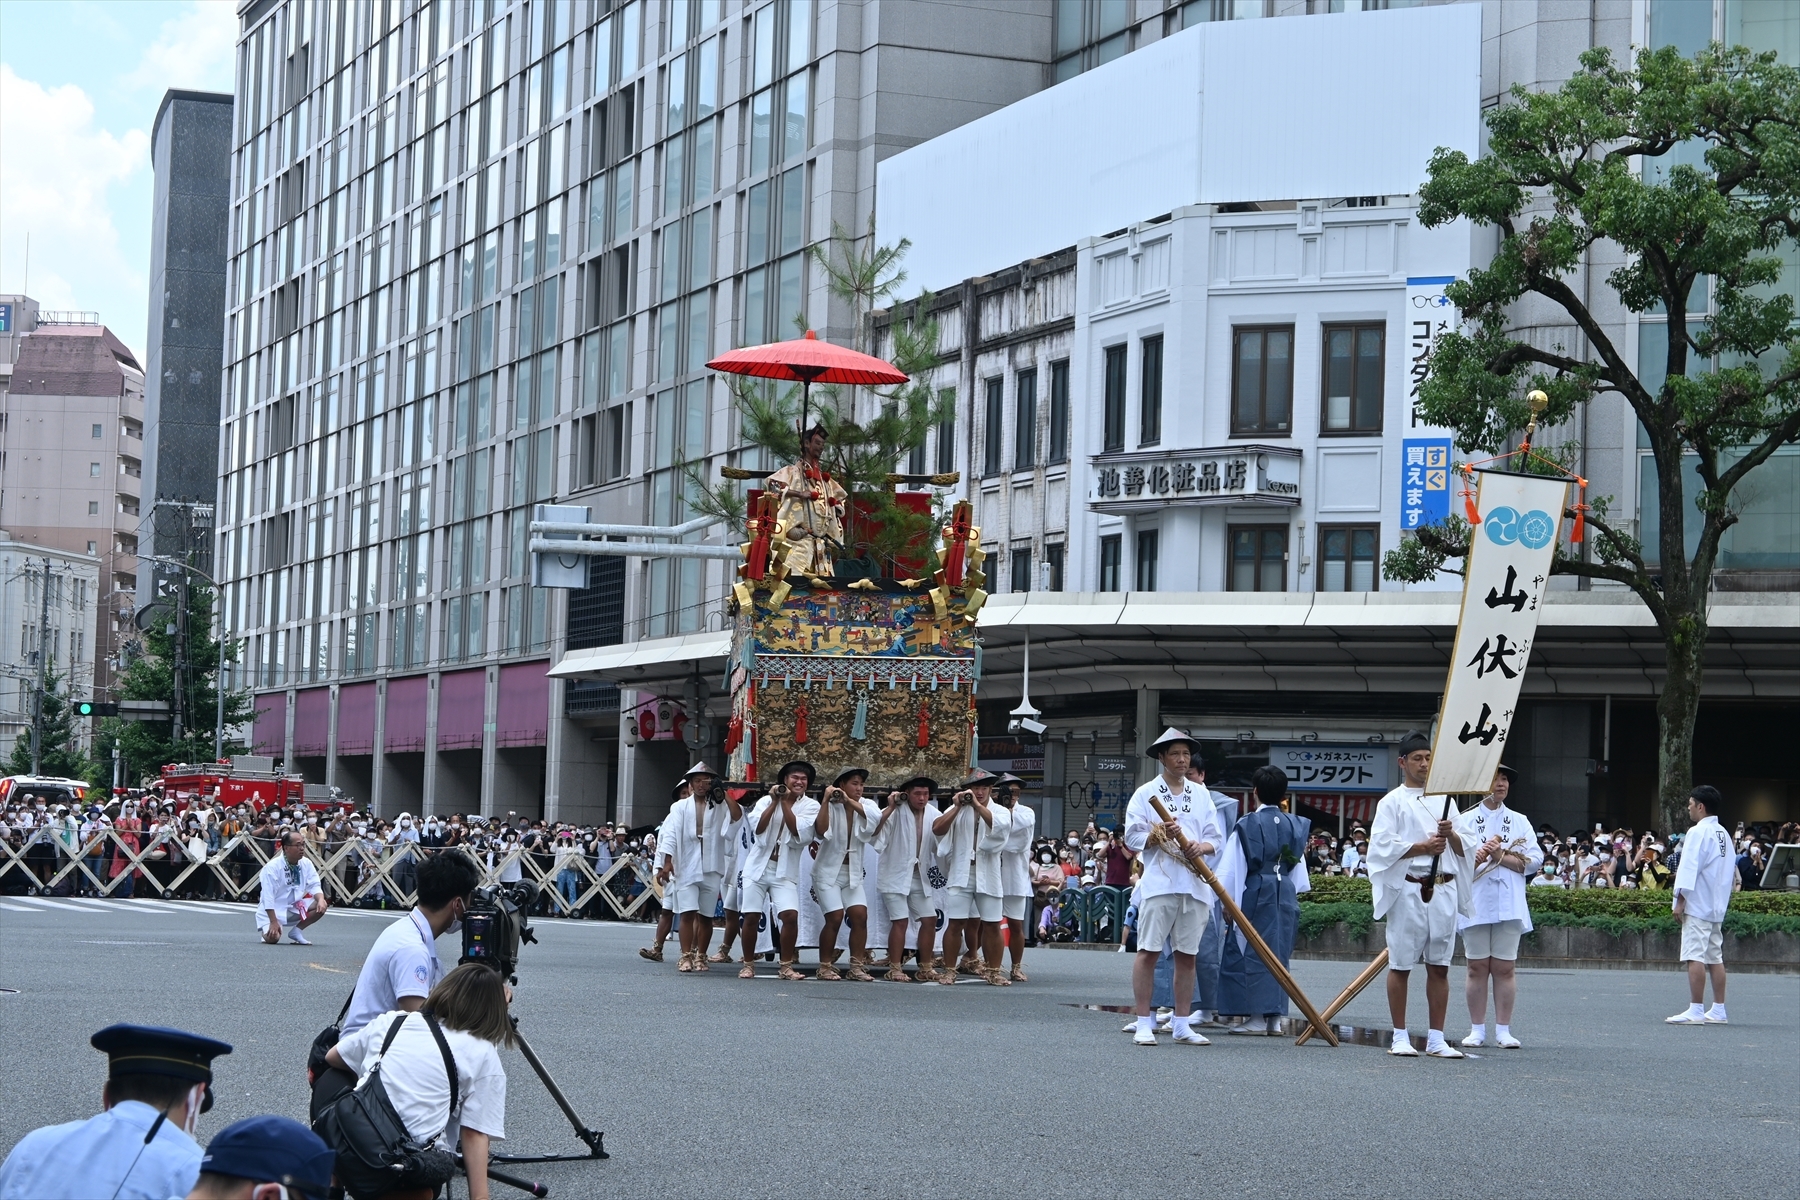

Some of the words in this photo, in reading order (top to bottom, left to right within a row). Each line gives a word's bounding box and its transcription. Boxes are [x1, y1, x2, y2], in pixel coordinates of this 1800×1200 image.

[1097, 459, 1248, 498] 池善化粧品店
[1405, 446, 1425, 526] 買えます
[1427, 447, 1446, 489] すぐ
[1457, 564, 1529, 747] 山伏山
[1011, 759, 1028, 770] ACCESS
[1285, 765, 1374, 784] コンタクト
[1314, 751, 1374, 762] メガネスーパー
